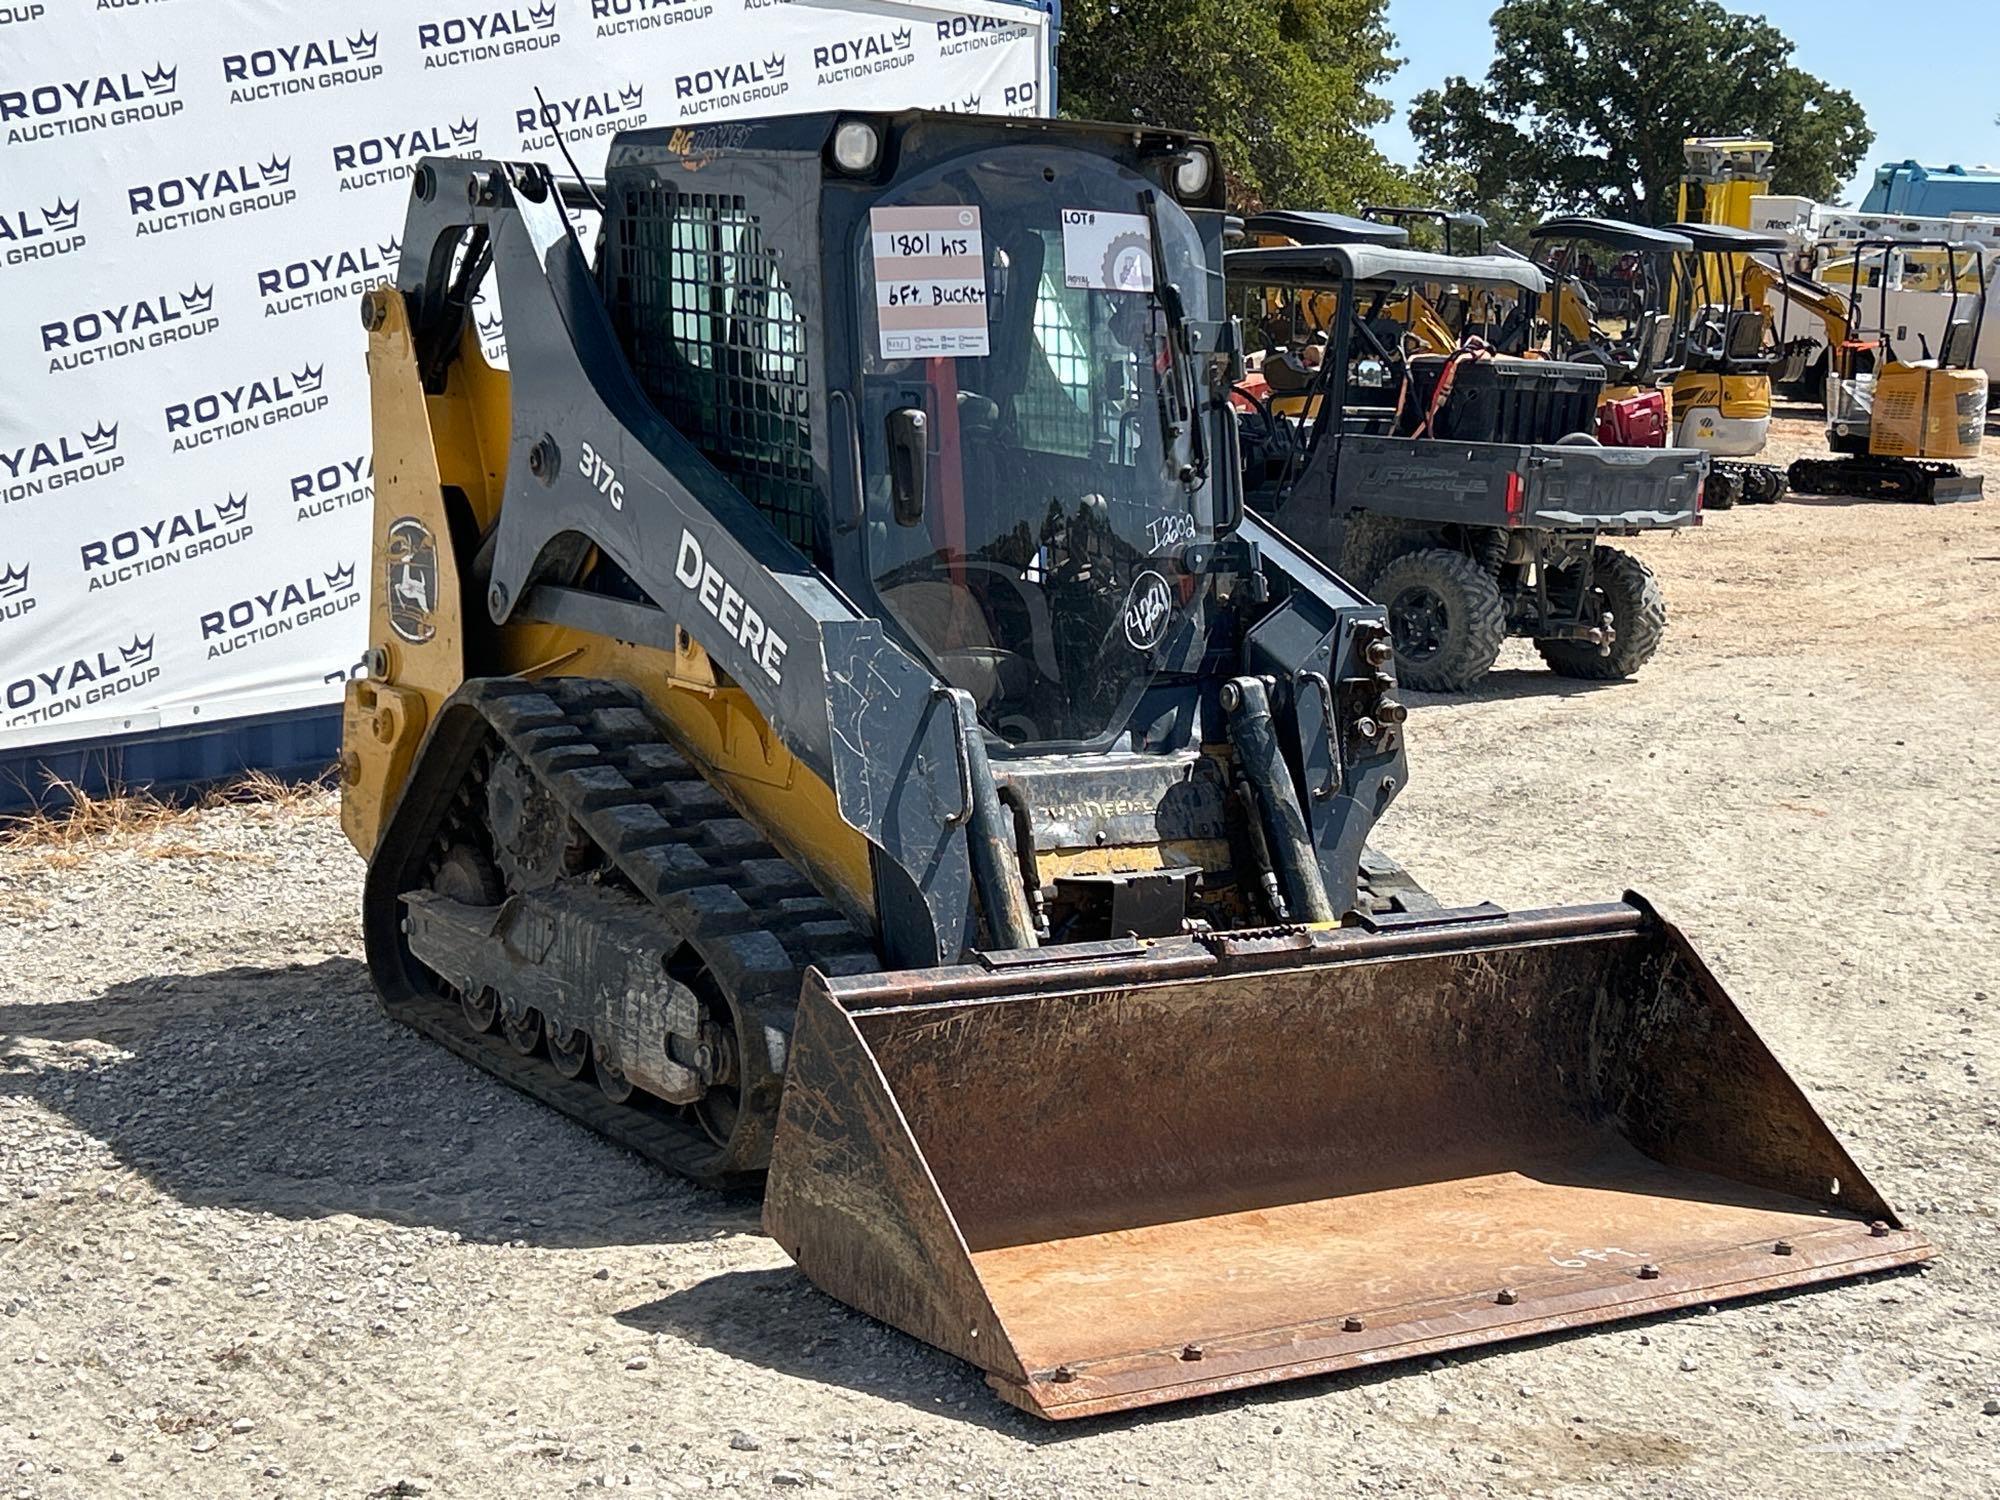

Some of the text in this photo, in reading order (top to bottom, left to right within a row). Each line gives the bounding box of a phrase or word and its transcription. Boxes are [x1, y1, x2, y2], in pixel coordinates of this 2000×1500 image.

[419, 10, 529, 49] ROYAL
[596, 15, 662, 38] AUCTION
[663, 6, 713, 26] GROUP
[940, 28, 1028, 57] AUCTION GROUP
[223, 41, 348, 82] ROYAL
[424, 34, 561, 69] AUCTION GROUP
[814, 33, 892, 69] ROYAL
[817, 54, 915, 86] AUCTION GROUP
[0, 73, 145, 122] ROYAL
[230, 64, 384, 104] AUCTION GROUP
[675, 61, 764, 99] ROYAL
[679, 82, 789, 117] AUCTION GROUP
[7, 100, 184, 146] AUCTION GROUP
[516, 92, 620, 133] ROYAL
[595, 114, 648, 136] GROUP
[333, 127, 450, 171] ROYAL
[128, 166, 260, 215] ROYAL
[136, 189, 297, 237] AUCTION GROUP
[6, 235, 86, 265] GROUP
[891, 233, 967, 258] 1801 hrs
[258, 247, 380, 297] ROYAL
[265, 284, 348, 318] AUCTION
[41, 297, 182, 352] ROYAL
[48, 316, 220, 375] AUCTION GROUP
[165, 376, 293, 432] ROYAL
[172, 395, 329, 453] AUCTION GROUP
[48, 456, 125, 490] GROUP
[579, 441, 625, 511] 317G
[81, 508, 216, 571] ROYAL
[88, 525, 253, 592] AUCTION GROUP
[200, 577, 326, 640] ROYAL
[207, 592, 361, 660] AUCTION GROUP
[674, 528, 788, 686] DEERE
[1126, 583, 1169, 637] 4221
[0, 652, 121, 714] OYAL
[86, 667, 160, 704] GROUP
